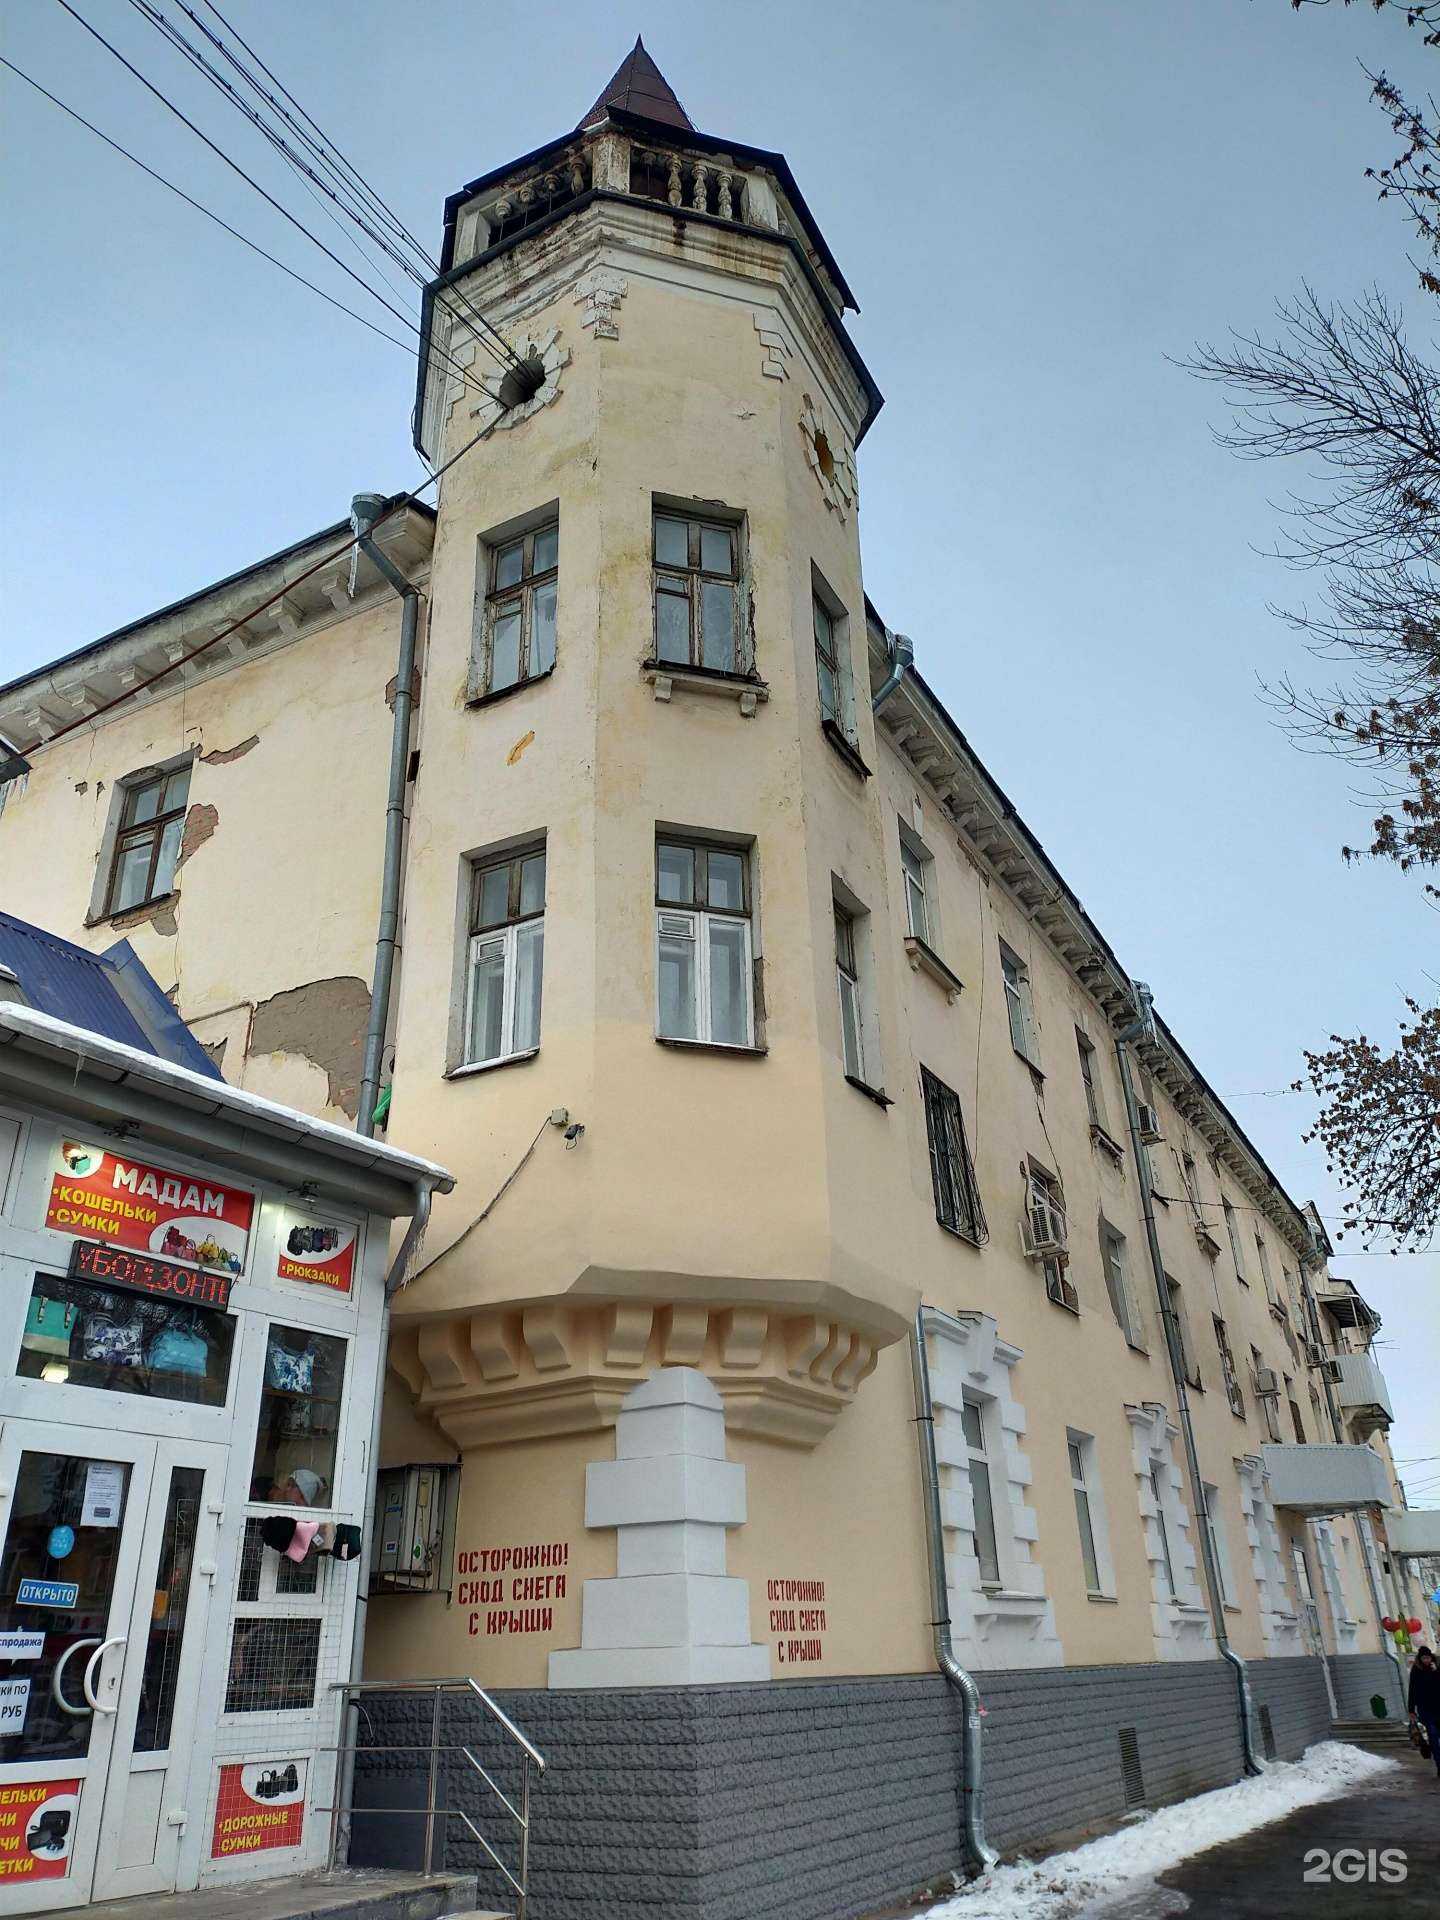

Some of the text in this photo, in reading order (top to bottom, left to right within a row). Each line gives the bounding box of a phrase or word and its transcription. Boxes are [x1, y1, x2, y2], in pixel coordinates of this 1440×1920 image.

[112, 1163, 225, 1217] МАДАМ
[59, 1185, 158, 1224] КОШЕЛЬКИ
[56, 1208, 121, 1236] СУМКИ
[286, 1263, 340, 1286] РЮКЗАКИ
[458, 1543, 569, 1574] ОСТОРОЖНО!
[21, 1585, 75, 1602] ОТКРЫТО
[458, 1574, 566, 1605] СХОД СНЕГА
[768, 1579, 825, 1602] ОСТОРОЖНО!
[469, 1607, 553, 1635] С КРЫШИ
[769, 1609, 826, 1632] СХОД СНЕГА
[778, 1639, 822, 1663] С КРЫШИ
[1, 1705, 22, 1719] РУБ
[0, 1787, 47, 1805] ЕЛЬКИ
[223, 1811, 289, 1834] ДОРОЖНЫЕ
[221, 1833, 262, 1852] СУМКИ
